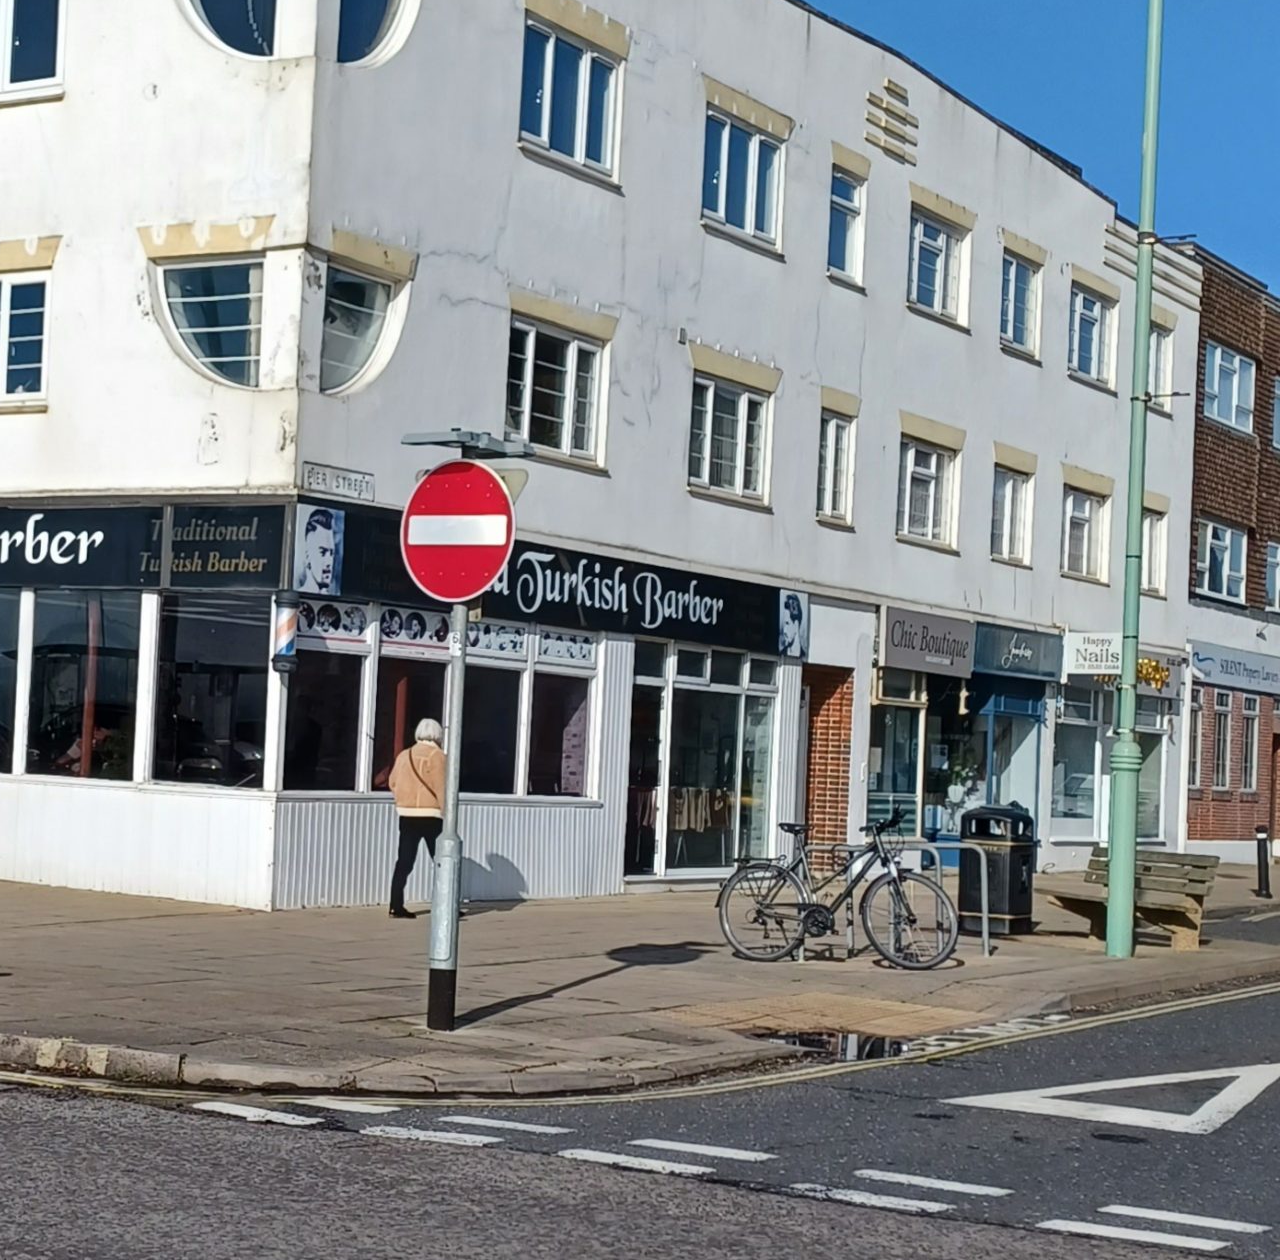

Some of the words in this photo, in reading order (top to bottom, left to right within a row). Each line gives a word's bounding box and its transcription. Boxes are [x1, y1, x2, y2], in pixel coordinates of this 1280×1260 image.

[307, 469, 327, 487] PIER
[336, 475, 370, 494] STREET
[151, 516, 258, 541] Taditional
[140, 551, 202, 572] Tukish
[207, 551, 267, 572] Barber
[516, 551, 628, 614] Turkish
[633, 572, 724, 630] Barber
[891, 620, 918, 651] Chic
[920, 625, 969, 666] Boutique
[1082, 636, 1113, 647] Happy
[1075, 648, 1120, 664] Nails
